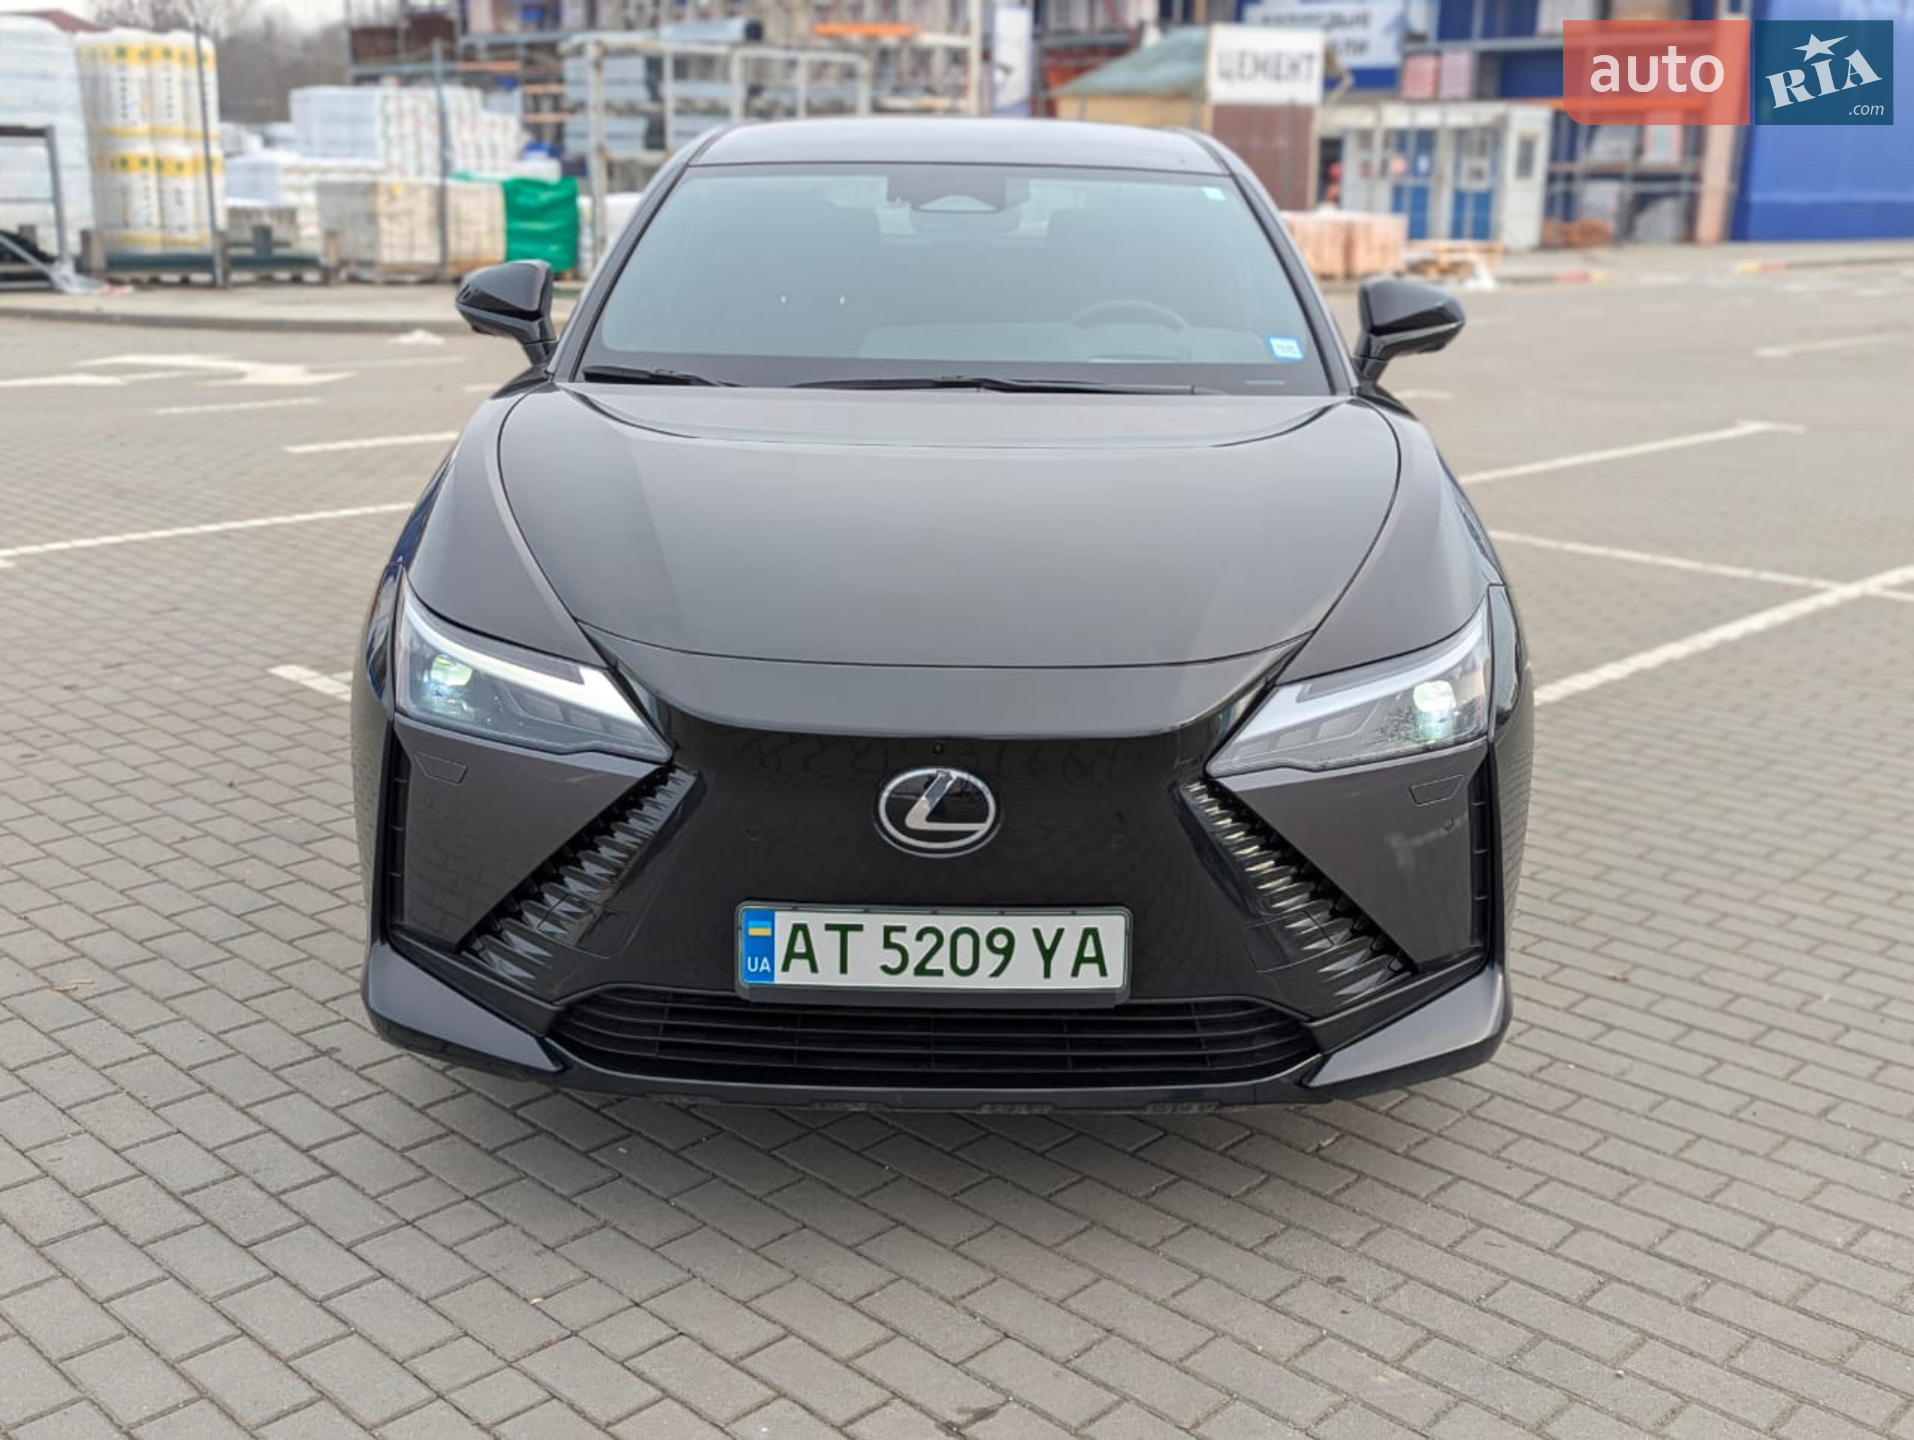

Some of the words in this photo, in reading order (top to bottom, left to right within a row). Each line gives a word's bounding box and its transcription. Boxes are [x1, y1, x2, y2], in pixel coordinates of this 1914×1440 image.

[1217, 50, 1316, 84] ЦЕМЕНТ
[747, 956, 772, 974] UA
[781, 922, 864, 975] AT
[879, 925, 1016, 978] 5209
[1032, 927, 1108, 979] YA
